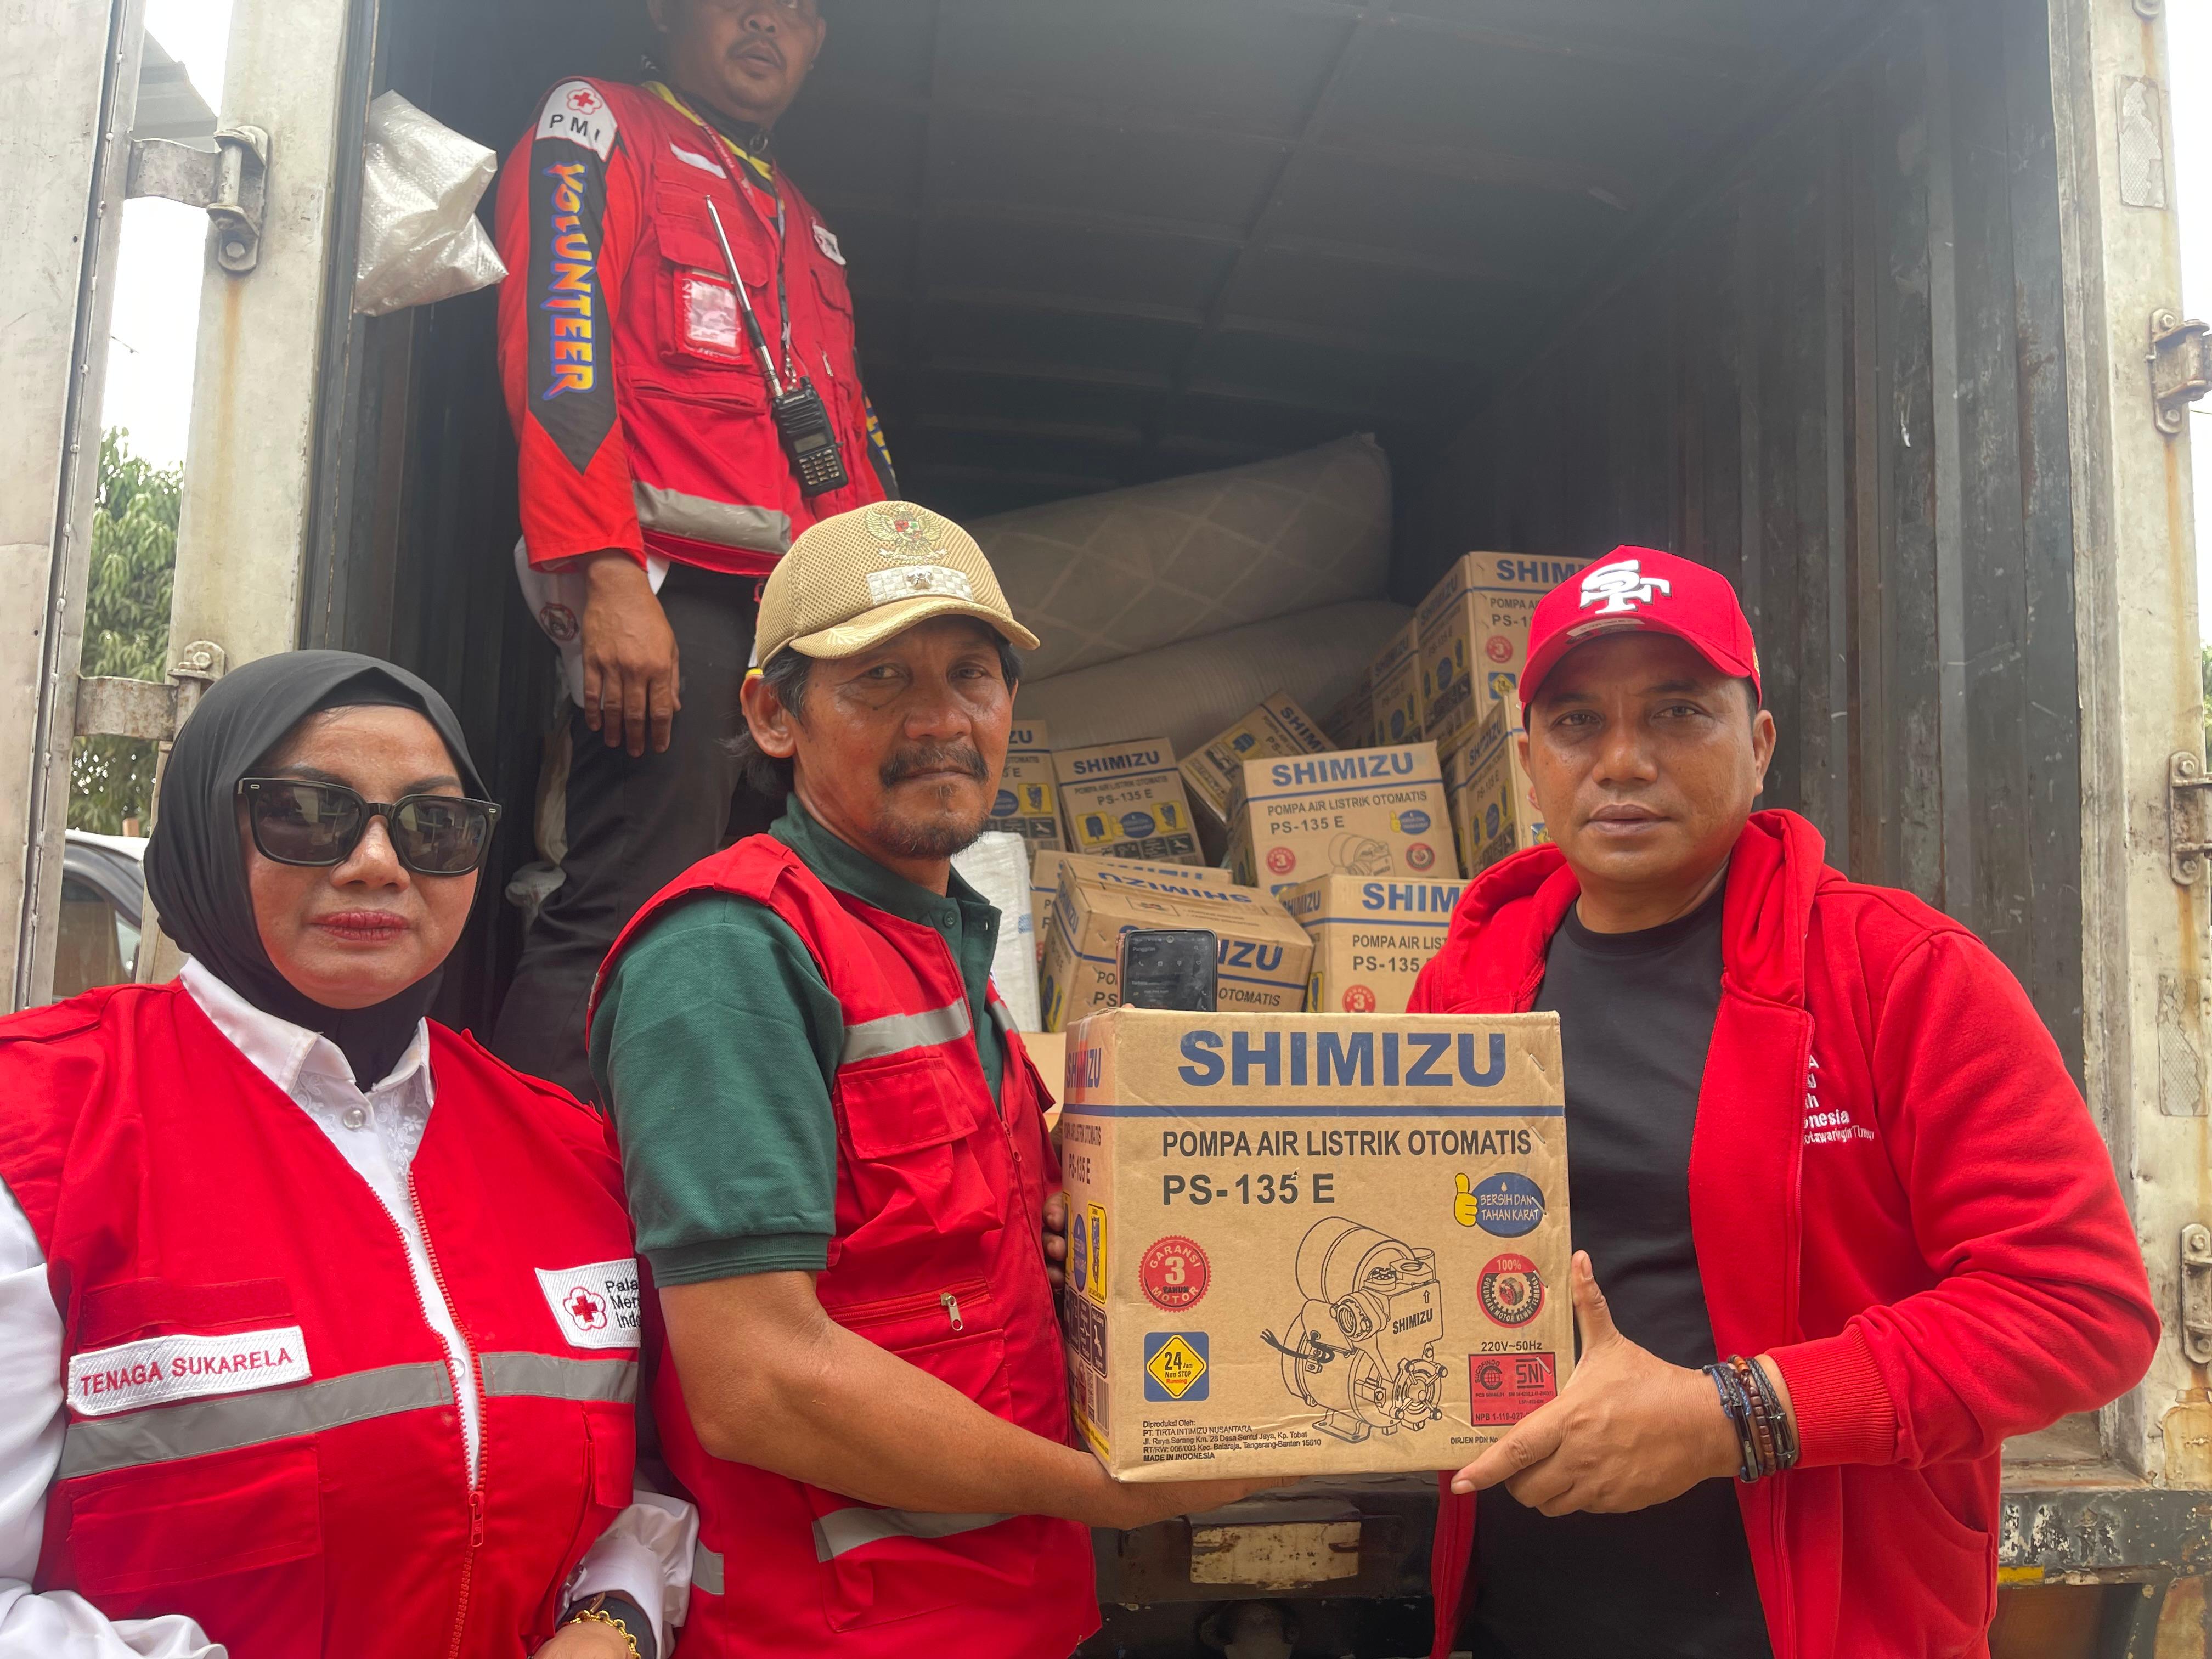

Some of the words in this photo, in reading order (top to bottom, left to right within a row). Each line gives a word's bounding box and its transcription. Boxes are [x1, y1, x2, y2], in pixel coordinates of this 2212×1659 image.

[549, 113, 601, 142] PMI
[1490, 597, 1526, 610] POMPA
[1074, 750, 1160, 775] SHIMIZU
[1272, 752, 1414, 787] SHIMIZU
[1097, 791, 1141, 806] PS-135
[1145, 789, 1153, 799] E
[1267, 803, 1306, 816] POMPA
[1308, 800, 1326, 812] AIR
[1329, 795, 1370, 810] LISTRIK
[1373, 790, 1427, 806] OTOMATIS
[1271, 818, 1328, 834] PS-135
[1334, 816, 1345, 828] E
[1098, 871, 1253, 904] SHIMIZU
[1353, 935, 1395, 949] POMPA
[1399, 936, 1420, 949] AIR
[1353, 956, 1420, 972] PS-135
[1219, 988, 1280, 1006] OTOMATIS
[1354, 994, 1364, 1009] 3
[1066, 1048, 1102, 1088] SHIMIZU
[1178, 1030, 1506, 1087] SHIMIZU
[1163, 1131, 1250, 1156] POMPA
[1256, 1130, 1299, 1156] AIR
[1307, 1130, 1401, 1155] LISTRIK
[1408, 1130, 1532, 1155] OTOMATIS
[1069, 1153, 1085, 1183] PS-135
[1086, 1158, 1090, 1184] E
[1163, 1173, 1299, 1205] PS-135
[1313, 1173, 1334, 1204] E
[1480, 1194, 1512, 1206] BERSIH
[1514, 1194, 1532, 1206] DAN
[1481, 1209, 1510, 1221] TAHAN
[1512, 1209, 1539, 1221] KARAT
[1149, 1245, 1201, 1268] GARANSI
[1497, 1259, 1522, 1271] 100%
[1165, 1256, 1185, 1284] 3
[1151, 1286, 1199, 1304] MOTOR
[1494, 1310, 1515, 1323] MOTOR
[1516, 1307, 1534, 1322] KAWAT
[1531, 1277, 1541, 1309] TEMBAGA
[1393, 1308, 1433, 1334] SHIMIZU
[1481, 1341, 1542, 1352] 220V~50Hz
[81, 1361, 163, 1396] TENAGA
[172, 1347, 292, 1377] SUKARELA
[1165, 1352, 1182, 1370] 24
[1475, 1359, 1500, 1384] SUCOFINDO
[1516, 1362, 1544, 1384] SNI
[1143, 1420, 1177, 1428] Diproduksi
[1209, 1425, 1252, 1434] NUSANTARA
[1175, 1452, 1215, 1460] INDONESIA
